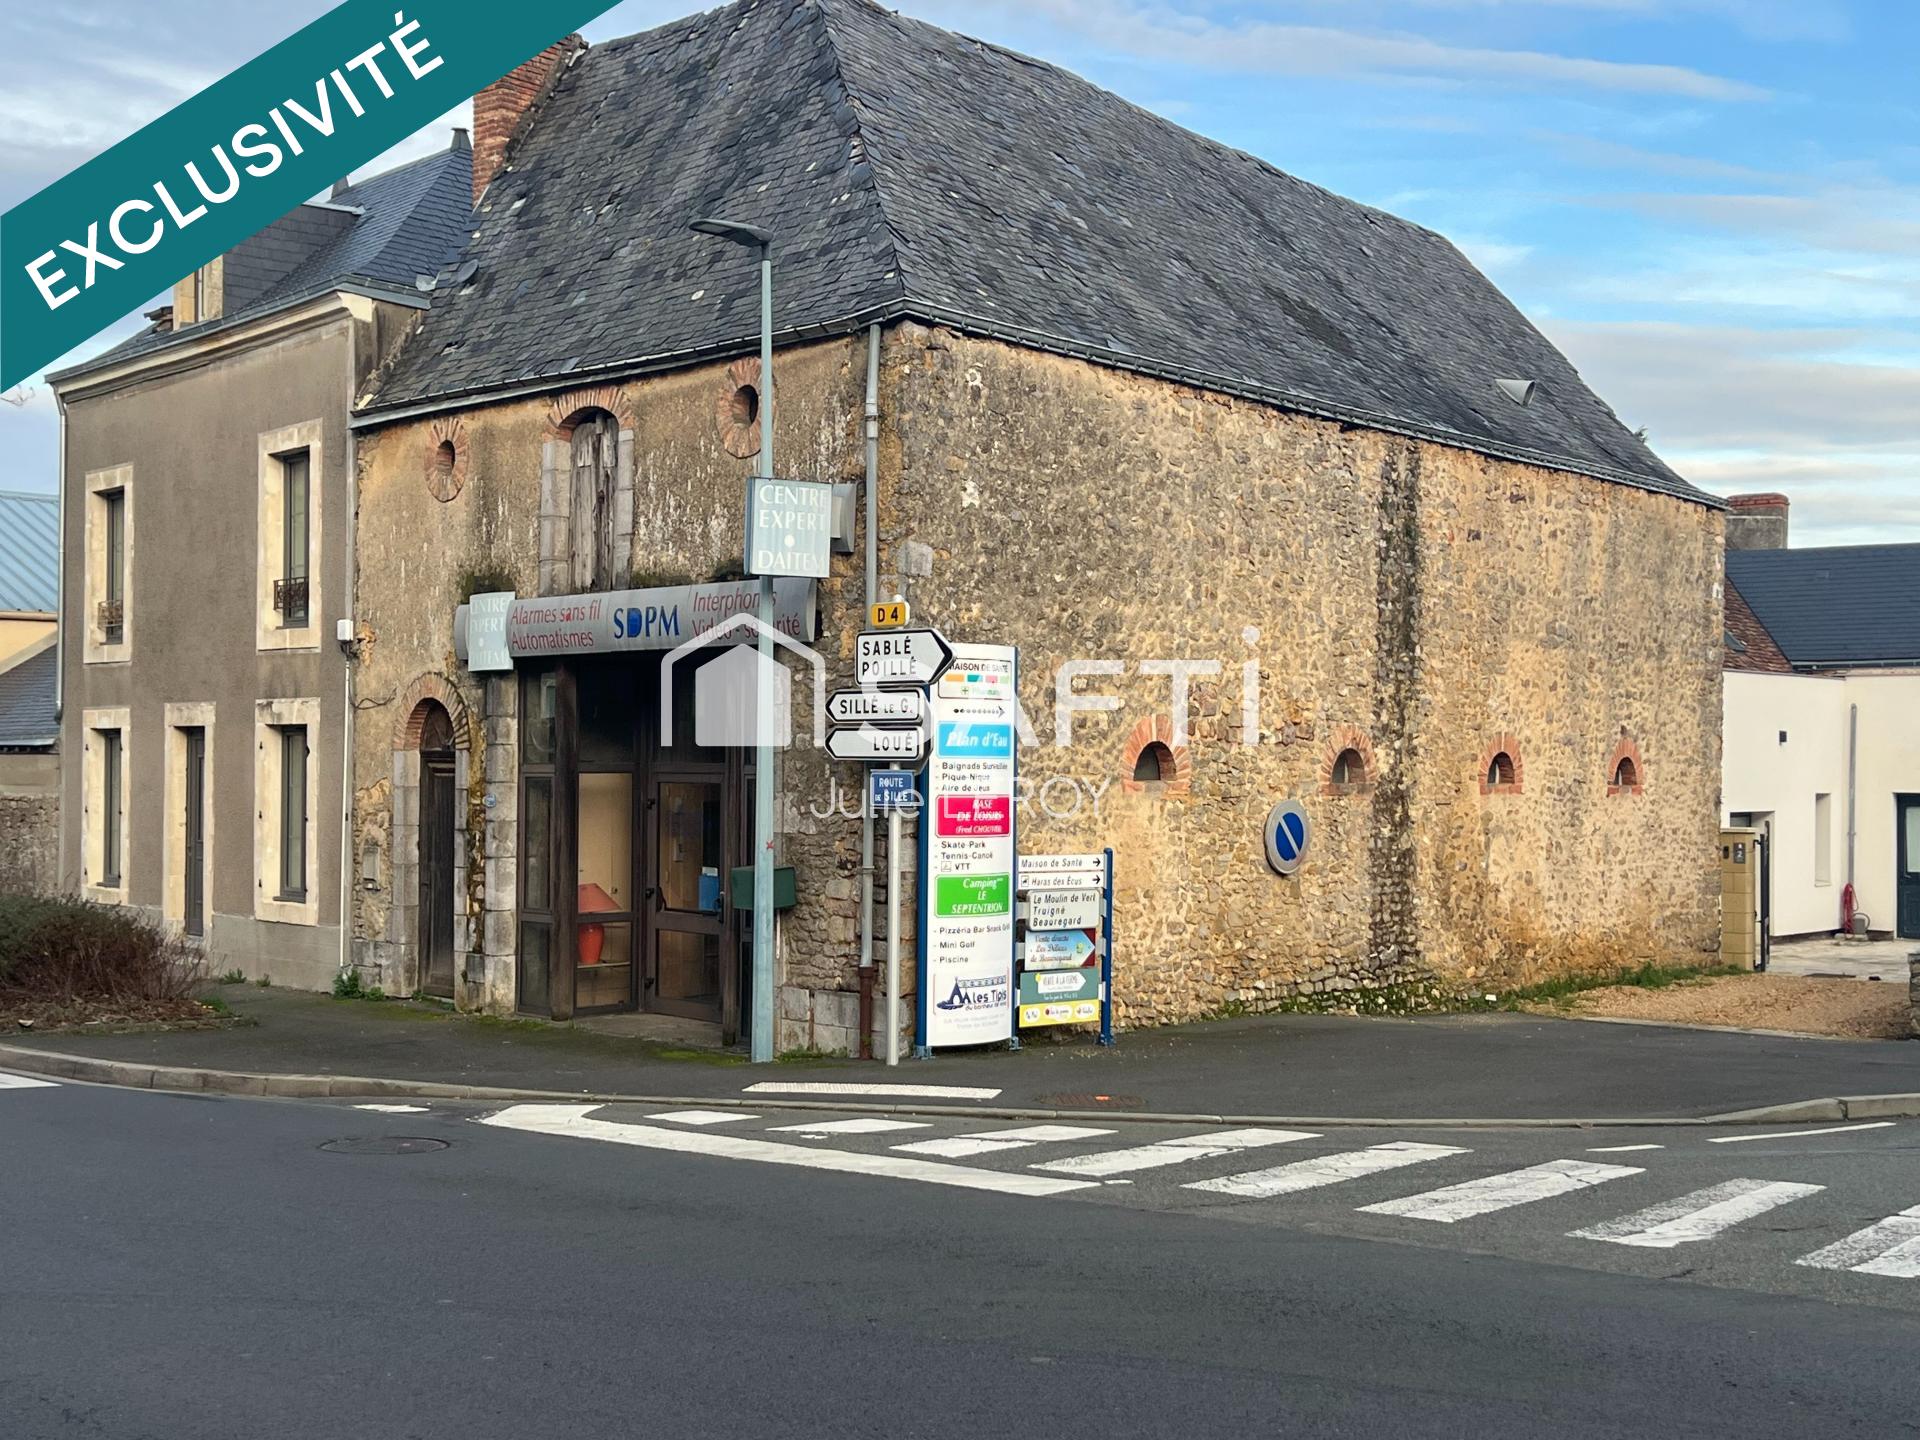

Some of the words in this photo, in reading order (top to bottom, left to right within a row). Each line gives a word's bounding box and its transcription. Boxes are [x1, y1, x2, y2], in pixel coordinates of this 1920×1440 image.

[759, 484, 828, 507] CENTRE
[760, 509, 827, 530] EXPERT
[693, 587, 777, 617] Interphons
[511, 605, 557, 625] Alarmes
[560, 604, 586, 621] sans
[589, 599, 602, 620] fil
[877, 608, 886, 622] D
[890, 607, 898, 622] 4
[613, 604, 680, 639] SDPM
[744, 612, 801, 639] sérité
[512, 628, 594, 650] Automatismes
[862, 636, 911, 656] SABLÉ
[862, 656, 917, 676] POILLÉ
[840, 695, 878, 714] SILLÉ
[884, 703, 894, 713] LE
[873, 732, 913, 751] LOUÉ
[946, 731, 979, 747] Plan
[942, 762, 980, 771] Baignade
[879, 777, 904, 788] ROUTE
[1021, 859, 1048, 868] Maison
[1051, 859, 1059, 867] de
[1062, 858, 1083, 867] Santé
[963, 877, 997, 890] Camping
[1032, 878, 1050, 886] Haras
[1053, 877, 1064, 886] des
[1067, 874, 1082, 885] Écus
[977, 891, 987, 900] LE
[1033, 894, 1041, 904] Le
[1044, 893, 1068, 903] Moulin
[1070, 893, 1079, 902] de
[951, 902, 1004, 914] SEPTENTRION
[1033, 906, 1065, 917] Truigné
[1033, 916, 1082, 928] Beauregard
[940, 926, 971, 934] Pizzéria
[973, 991, 989, 1003] les
